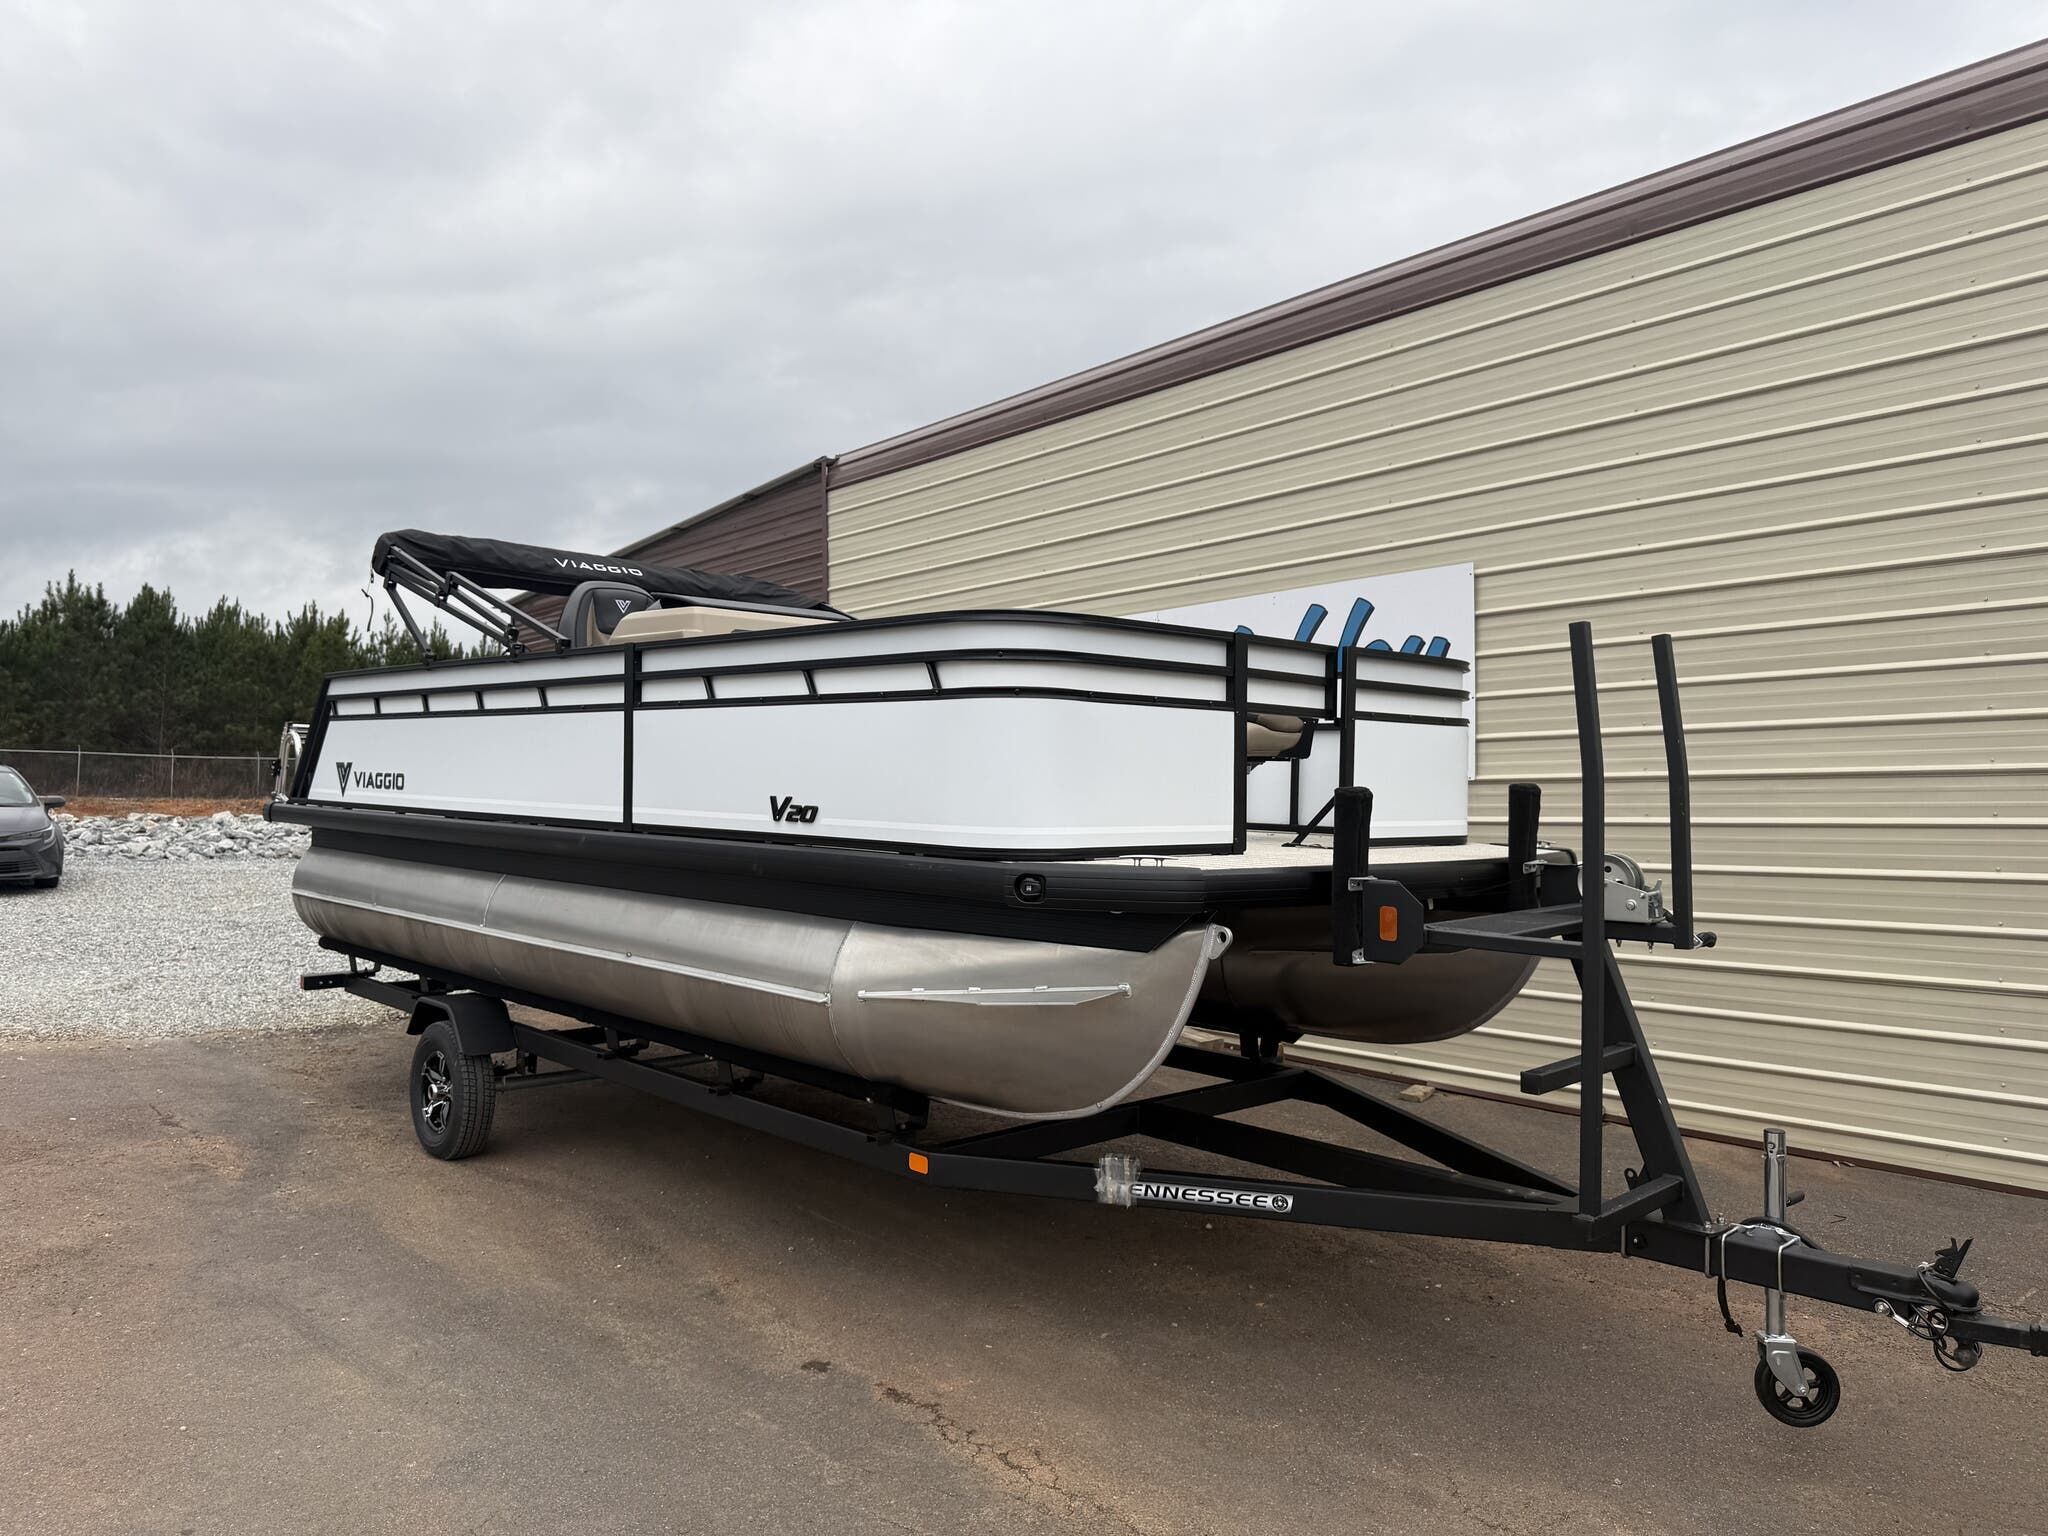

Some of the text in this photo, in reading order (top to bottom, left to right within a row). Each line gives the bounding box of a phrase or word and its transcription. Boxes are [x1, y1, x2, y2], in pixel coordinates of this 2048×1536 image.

[554, 557, 643, 576] VIAGGIO
[354, 771, 405, 790] VIAGGIO
[770, 796, 819, 823] V20
[1129, 1183, 1269, 1208] ENNESSEE
